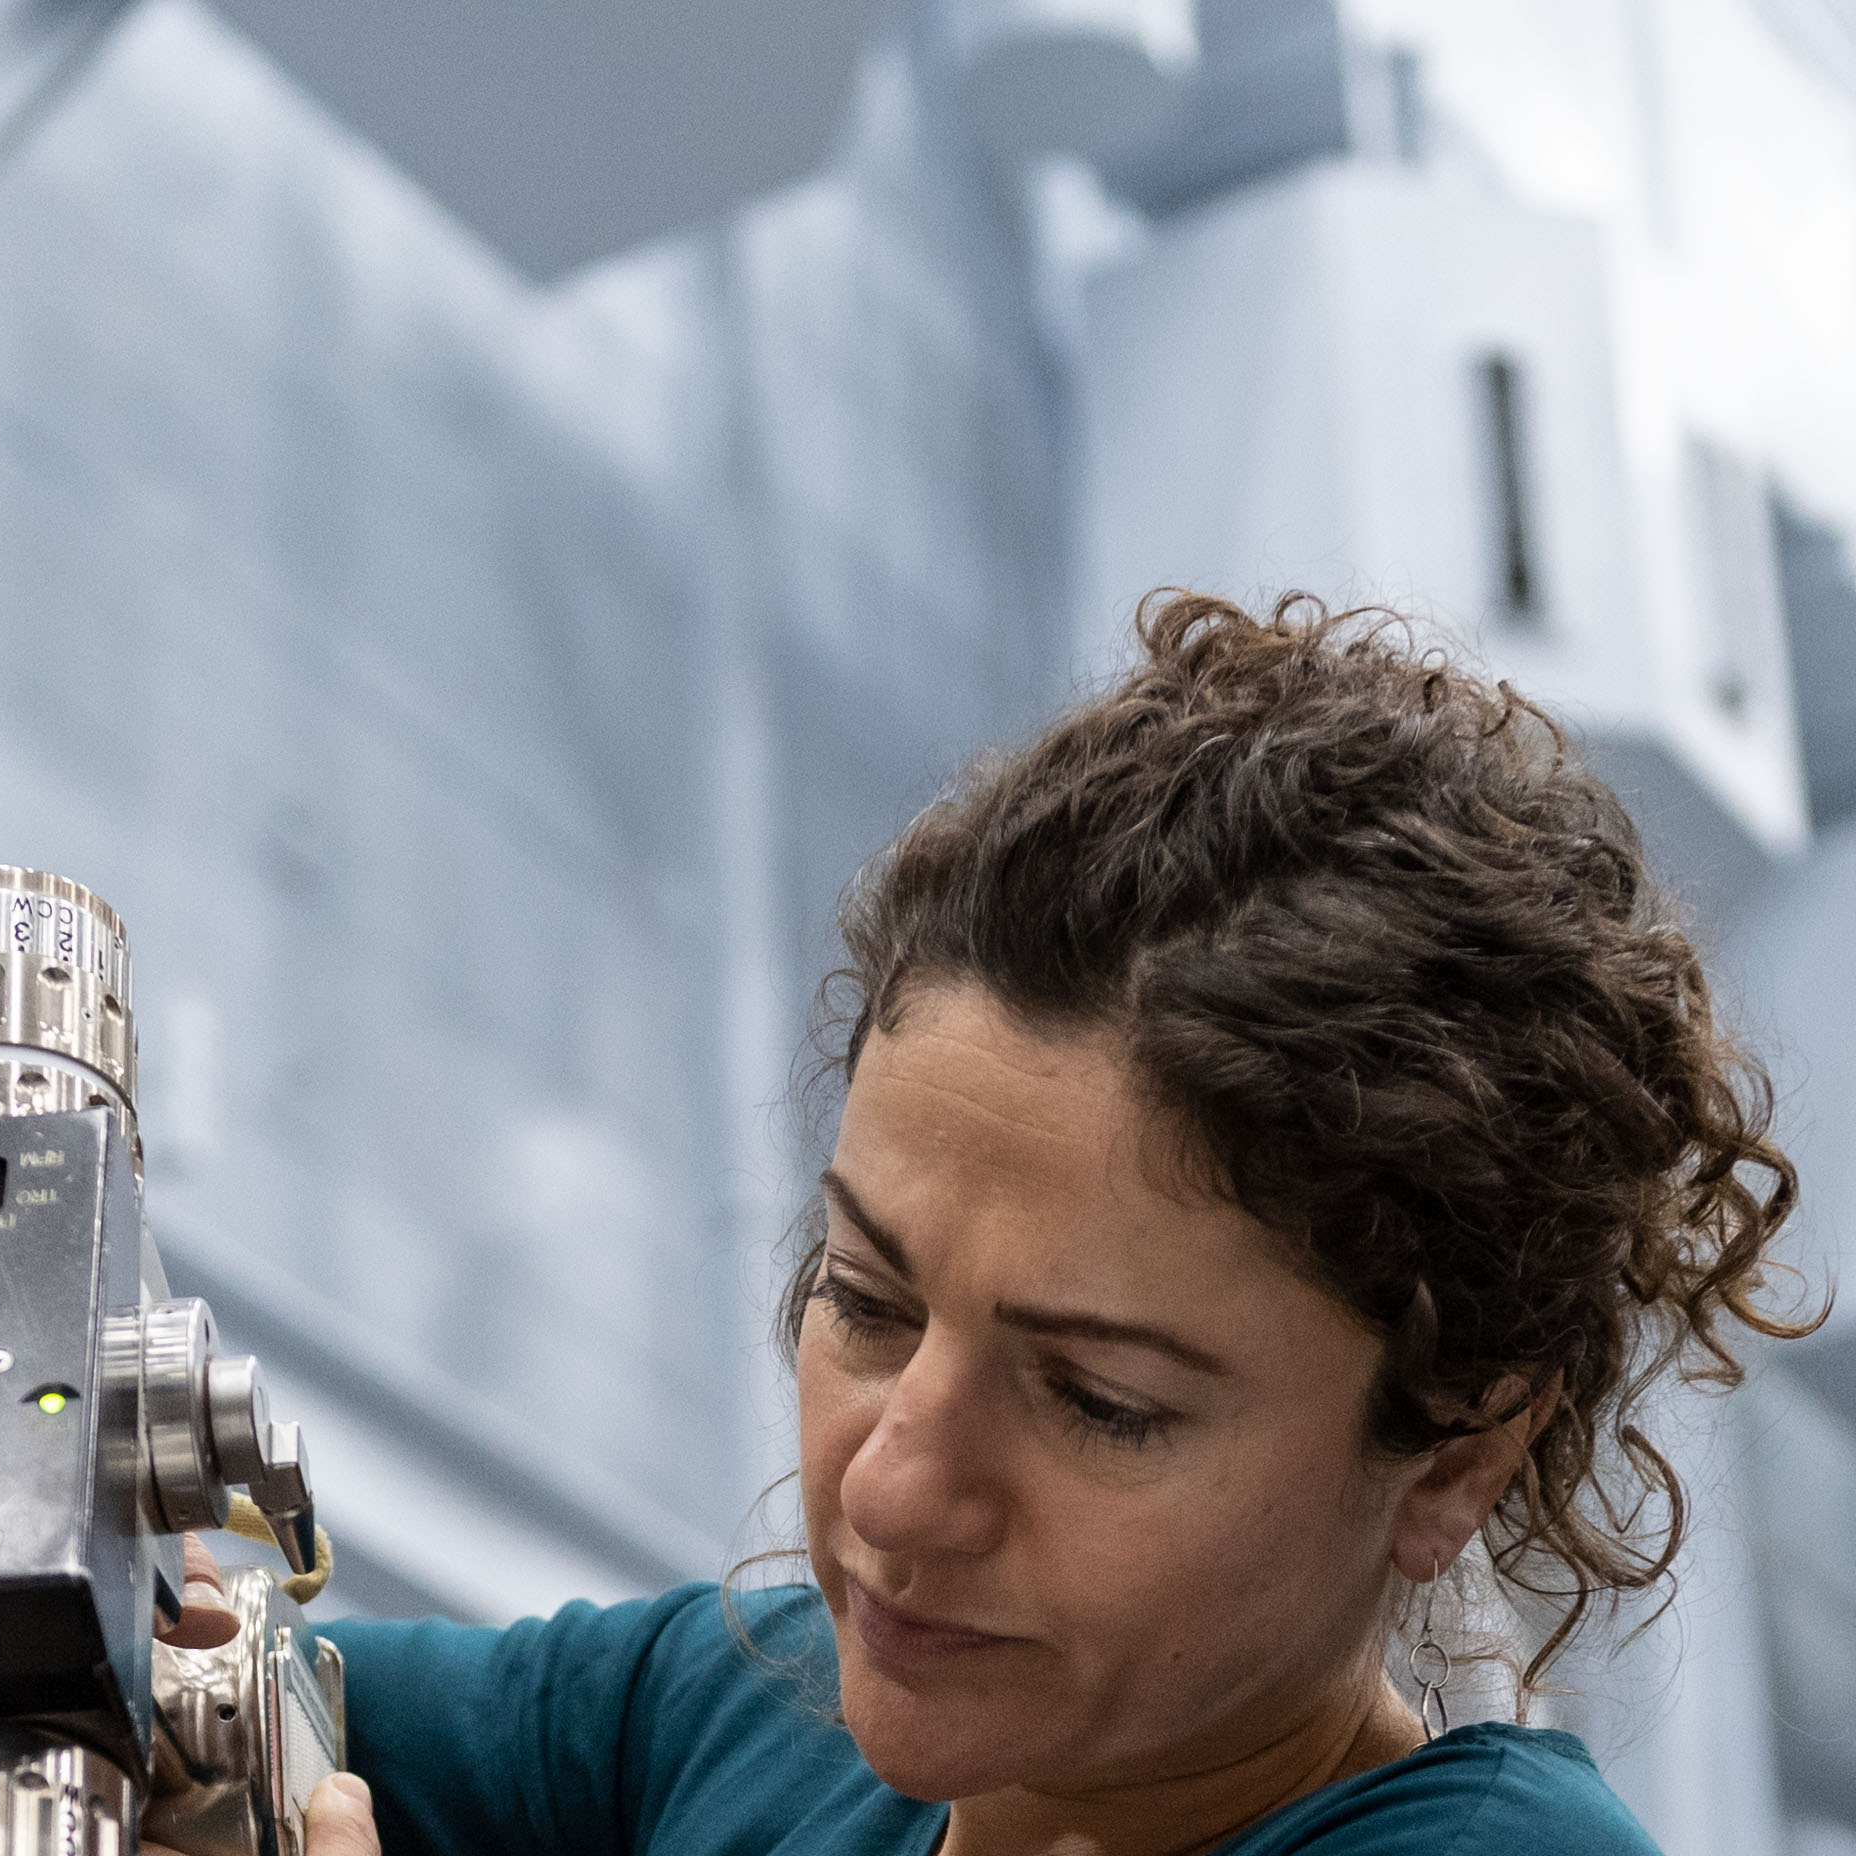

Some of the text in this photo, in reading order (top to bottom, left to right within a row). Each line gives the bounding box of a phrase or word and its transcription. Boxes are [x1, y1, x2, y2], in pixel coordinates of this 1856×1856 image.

[13, 897, 74, 924] CCW
[14, 921, 31, 943] 3
[58, 930, 73, 952] 2
[20, 1150, 64, 1167] RPM
